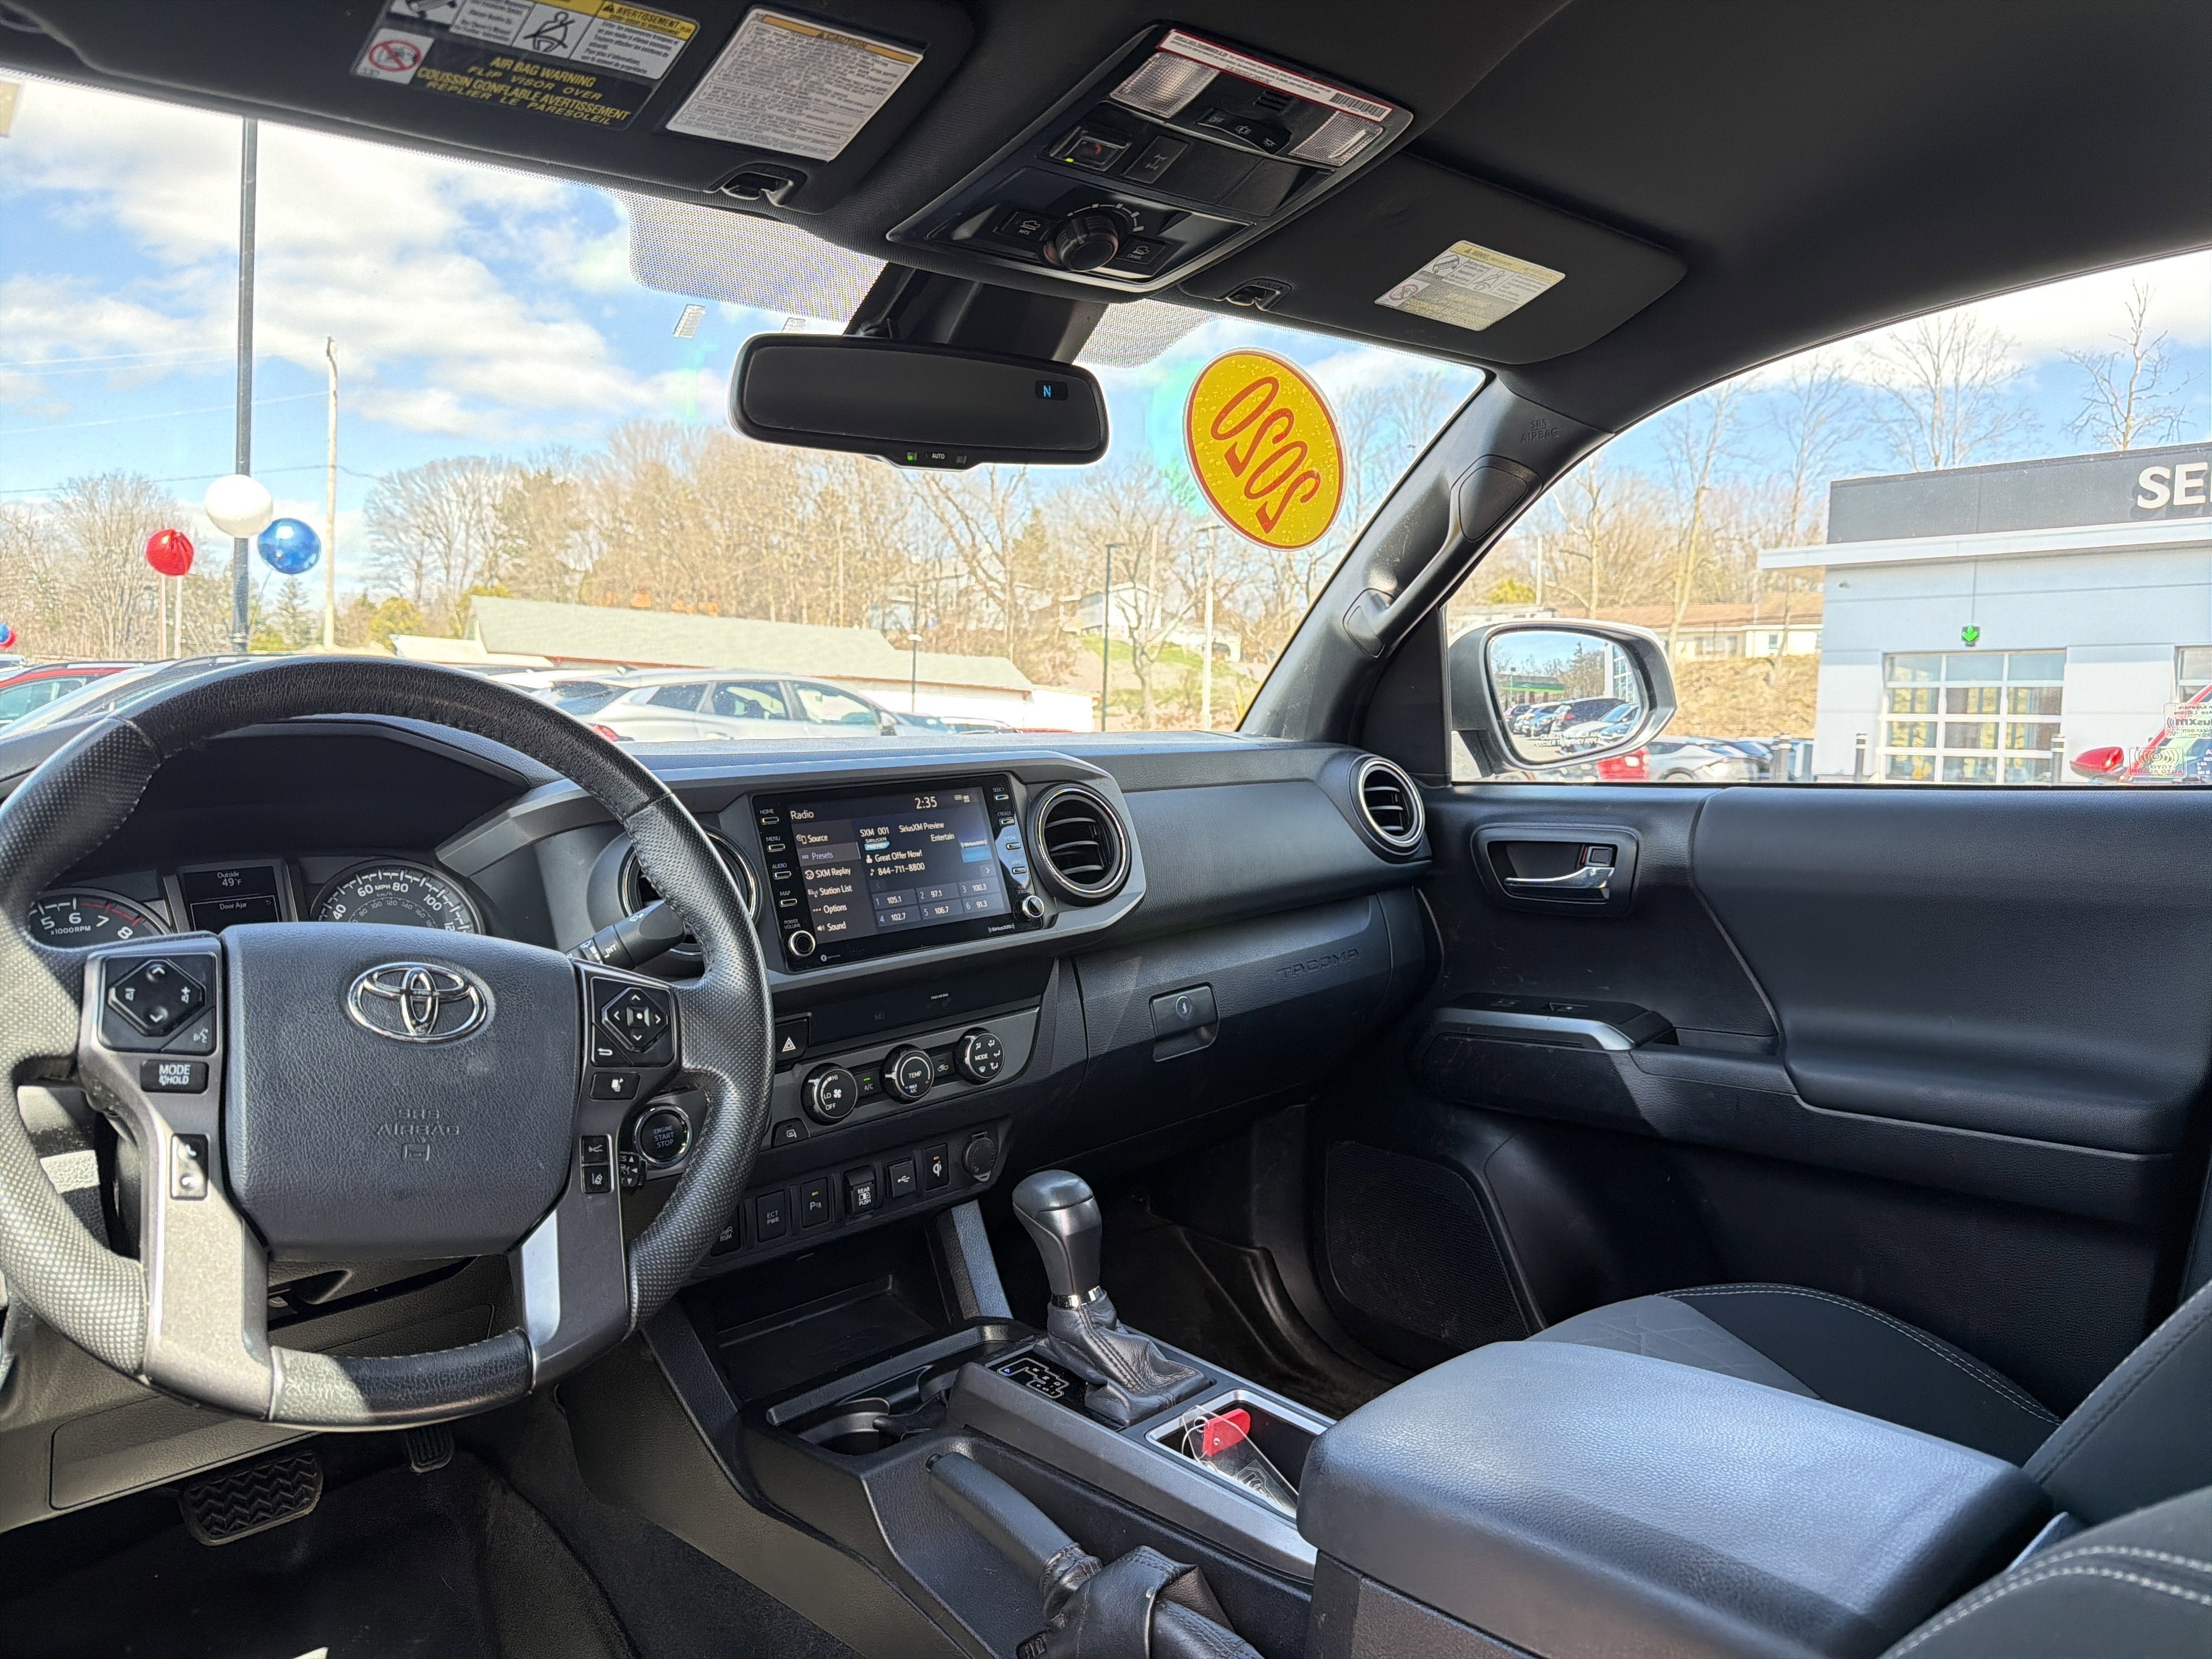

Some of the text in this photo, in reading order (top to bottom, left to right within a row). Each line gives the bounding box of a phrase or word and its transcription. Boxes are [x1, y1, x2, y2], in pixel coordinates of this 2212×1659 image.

[490, 57, 596, 88] AIR BAG WARNING
[467, 65, 602, 101] FLIP VISOR OVER
[417, 66, 473, 88] COUSSIN
[541, 93, 631, 121] AVERTISSEMENT
[426, 81, 611, 125] REPLIER LE PARESOLEIL
[1209, 116, 1225, 124] OFF
[1043, 385, 1051, 398] N
[1531, 419, 1547, 428] SRS
[1520, 428, 1558, 443] AIRBAG
[2137, 462, 2212, 509] SE
[915, 796, 938, 809] 2:35
[790, 810, 814, 820] Radio
[860, 827, 890, 837] SXM 001
[899, 822, 945, 833] SiriusXM Preview
[808, 834, 828, 843] Source
[930, 832, 955, 842] Entertain
[811, 851, 833, 860] Presets
[874, 849, 923, 862] Great Offer Now!
[217, 870, 240, 878] Outside
[815, 867, 851, 878] SXM Replay
[877, 862, 925, 876] 844-711-8800
[221, 878, 242, 887] 49°F
[392, 882, 409, 893] 80
[357, 884, 374, 897] 60
[819, 884, 853, 896] Station List
[930, 890, 943, 898] 97.1
[423, 894, 443, 911] 100
[887, 896, 902, 904] 105.1
[976, 900, 988, 909] 91.3
[219, 901, 247, 911] Door Ajar
[401, 901, 413, 910] 140
[823, 904, 847, 914] Options
[934, 906, 949, 915] 106.7
[332, 904, 347, 920] 40
[359, 908, 368, 917] 80
[415, 909, 426, 918] 160
[890, 912, 906, 921] 102.7
[40, 916, 55, 929] 5
[69, 912, 81, 924] 6
[95, 915, 109, 927] 7
[425, 919, 434, 928] 180
[444, 922, 455, 932] 12
[827, 921, 847, 932] Sound
[117, 926, 133, 939] 8
[607, 944, 617, 953] INT
[1276, 948, 1360, 978] TACOMA
[974, 1053, 989, 1062] MODE
[159, 1064, 191, 1075] MODE
[908, 1071, 922, 1079] TEMP
[167, 1076, 189, 1085] HOLD
[398, 1109, 439, 1119] SRS
[376, 1122, 460, 1136] AIRBAG
[653, 1126, 673, 1134] ENGINE
[654, 1132, 674, 1141] START
[657, 1139, 674, 1148] STOP
[767, 1210, 779, 1219] ECT
[767, 1217, 780, 1225] PWR
[720, 1234, 732, 1242] BSM
